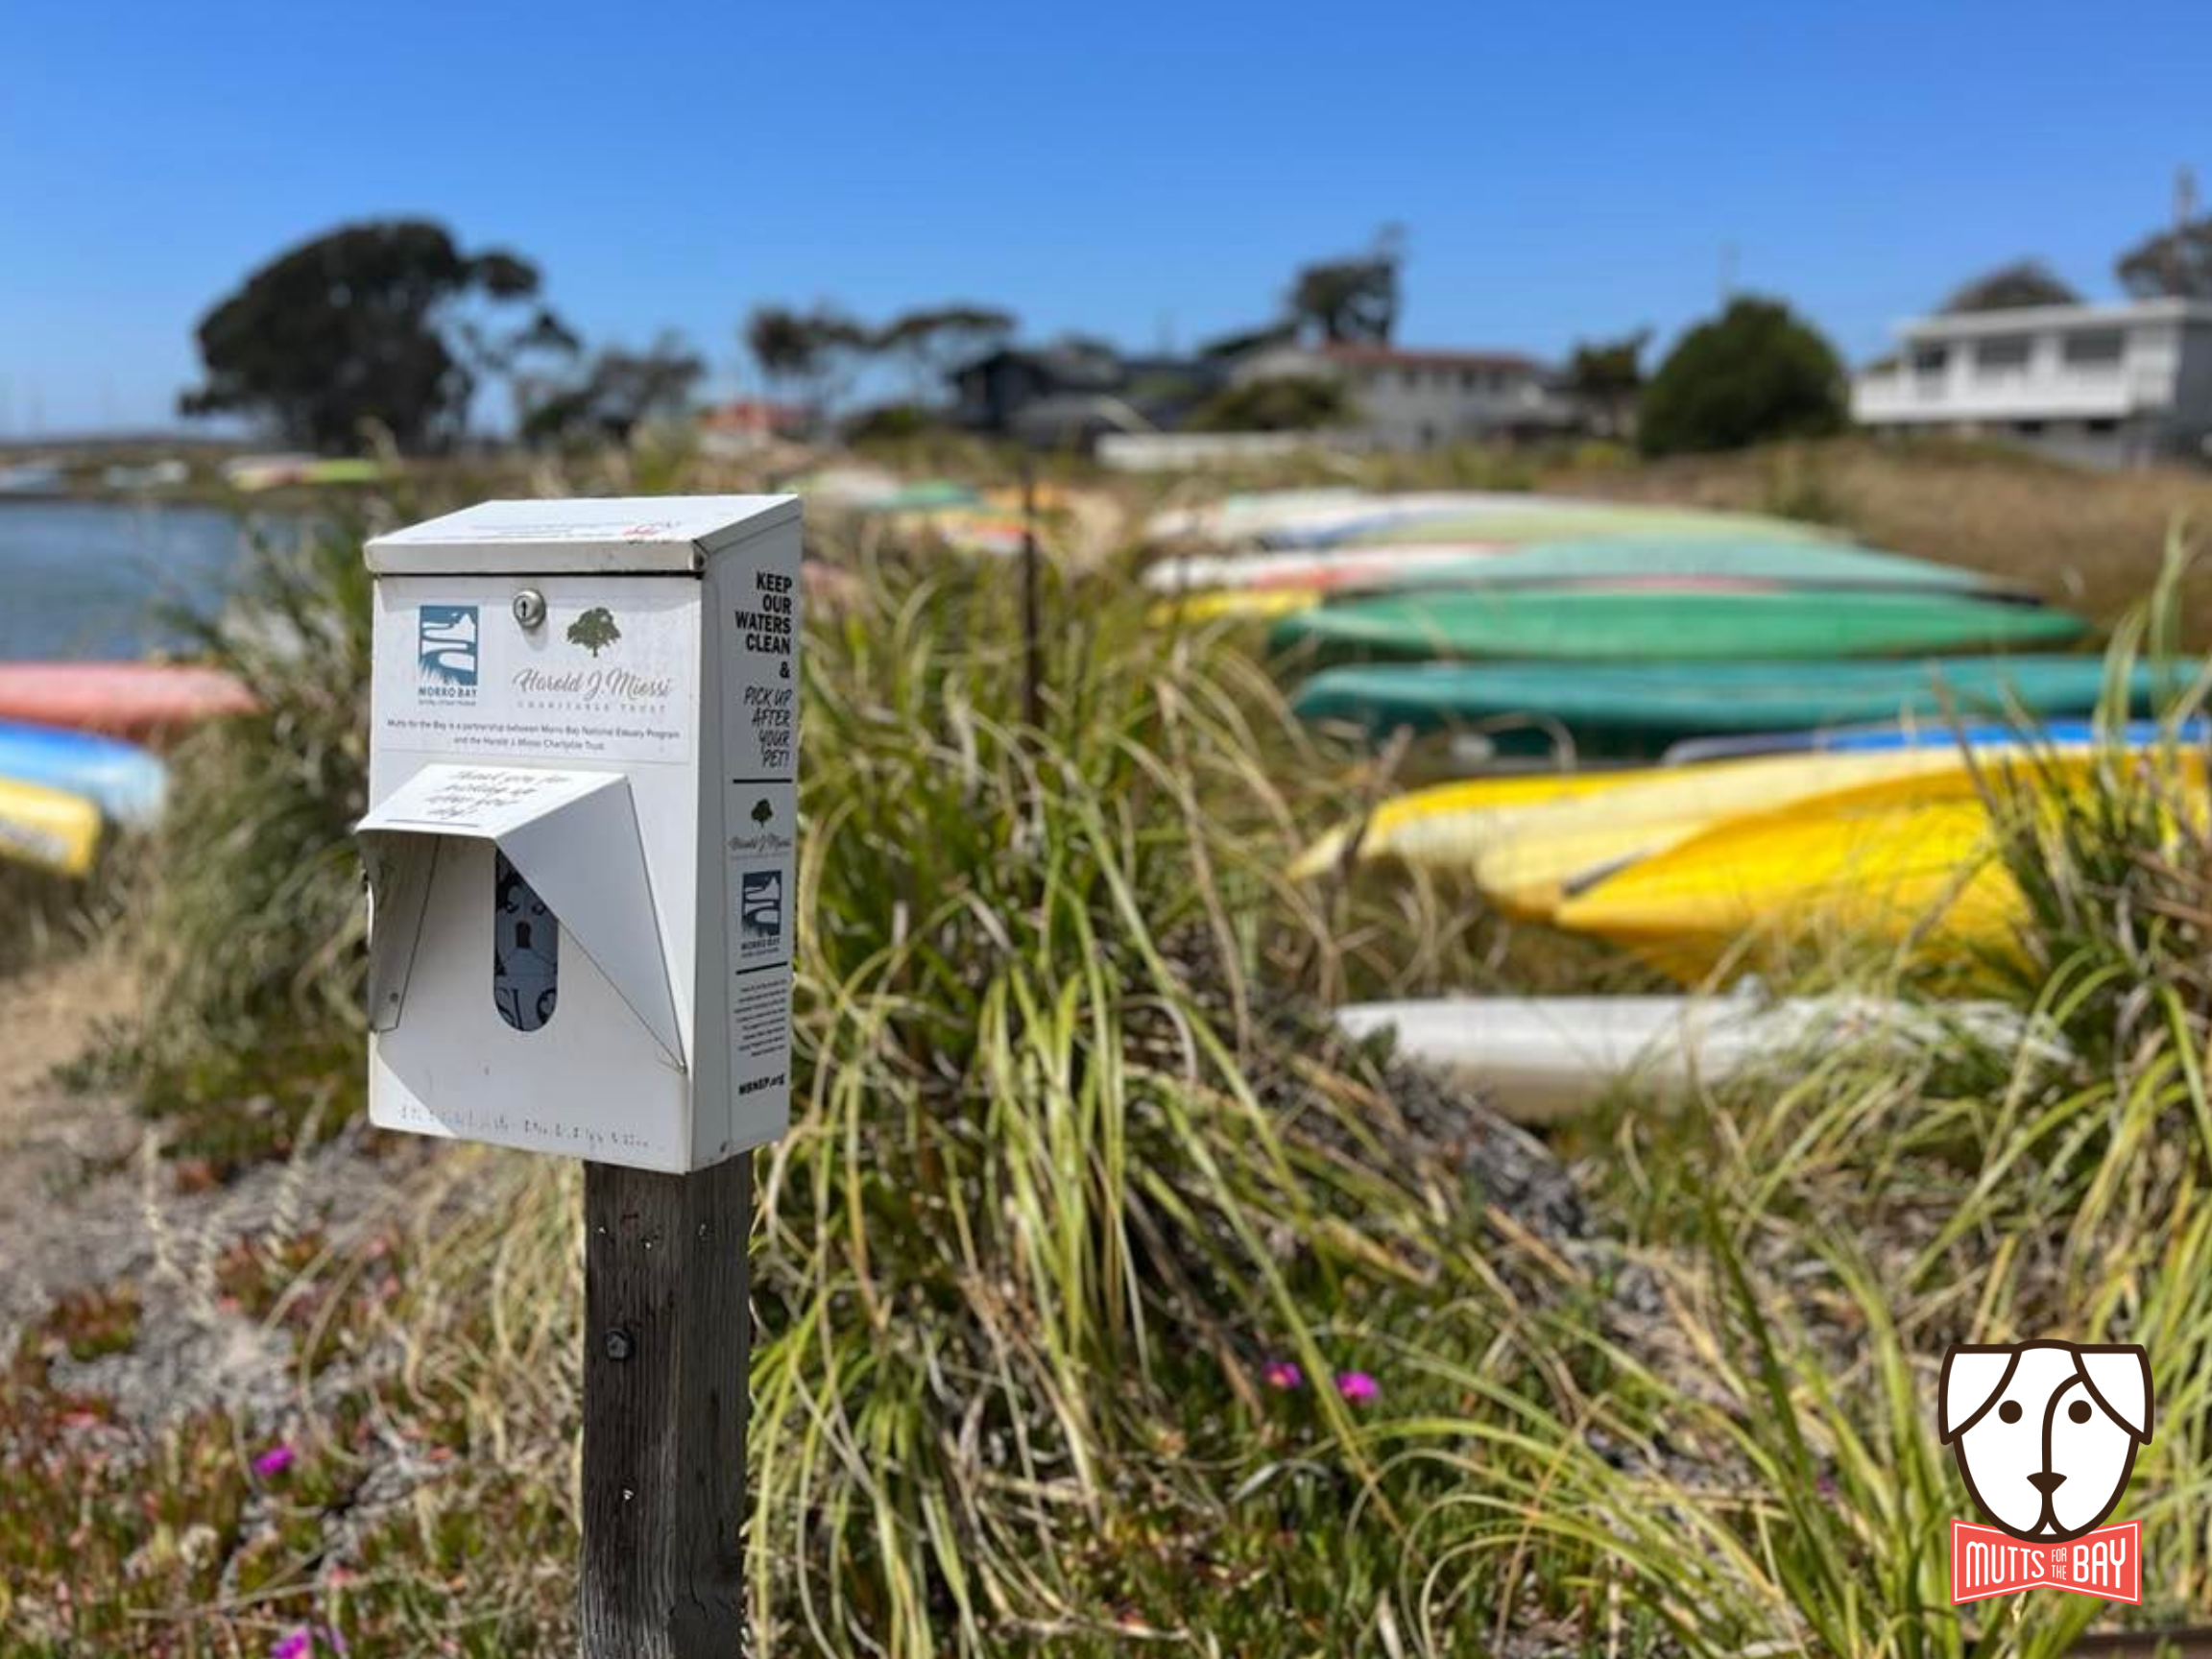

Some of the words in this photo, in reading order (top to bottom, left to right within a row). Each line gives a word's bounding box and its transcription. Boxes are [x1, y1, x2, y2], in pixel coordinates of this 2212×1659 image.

[756, 571, 792, 593] KEEP
[762, 594, 792, 615] OUR
[734, 611, 792, 636] WATERS
[745, 633, 791, 656] CLEAN
[779, 661, 790, 679] &
[419, 686, 456, 698] MORRO
[457, 687, 477, 698] BAY
[512, 668, 583, 693] Harold
[583, 671, 604, 702] J.
[605, 667, 671, 700] Miossi
[743, 685, 772, 708] PICK
[774, 688, 792, 706] UP
[752, 708, 791, 728] AFTER
[758, 730, 791, 754] YOUR
[762, 750, 790, 769] PET!
